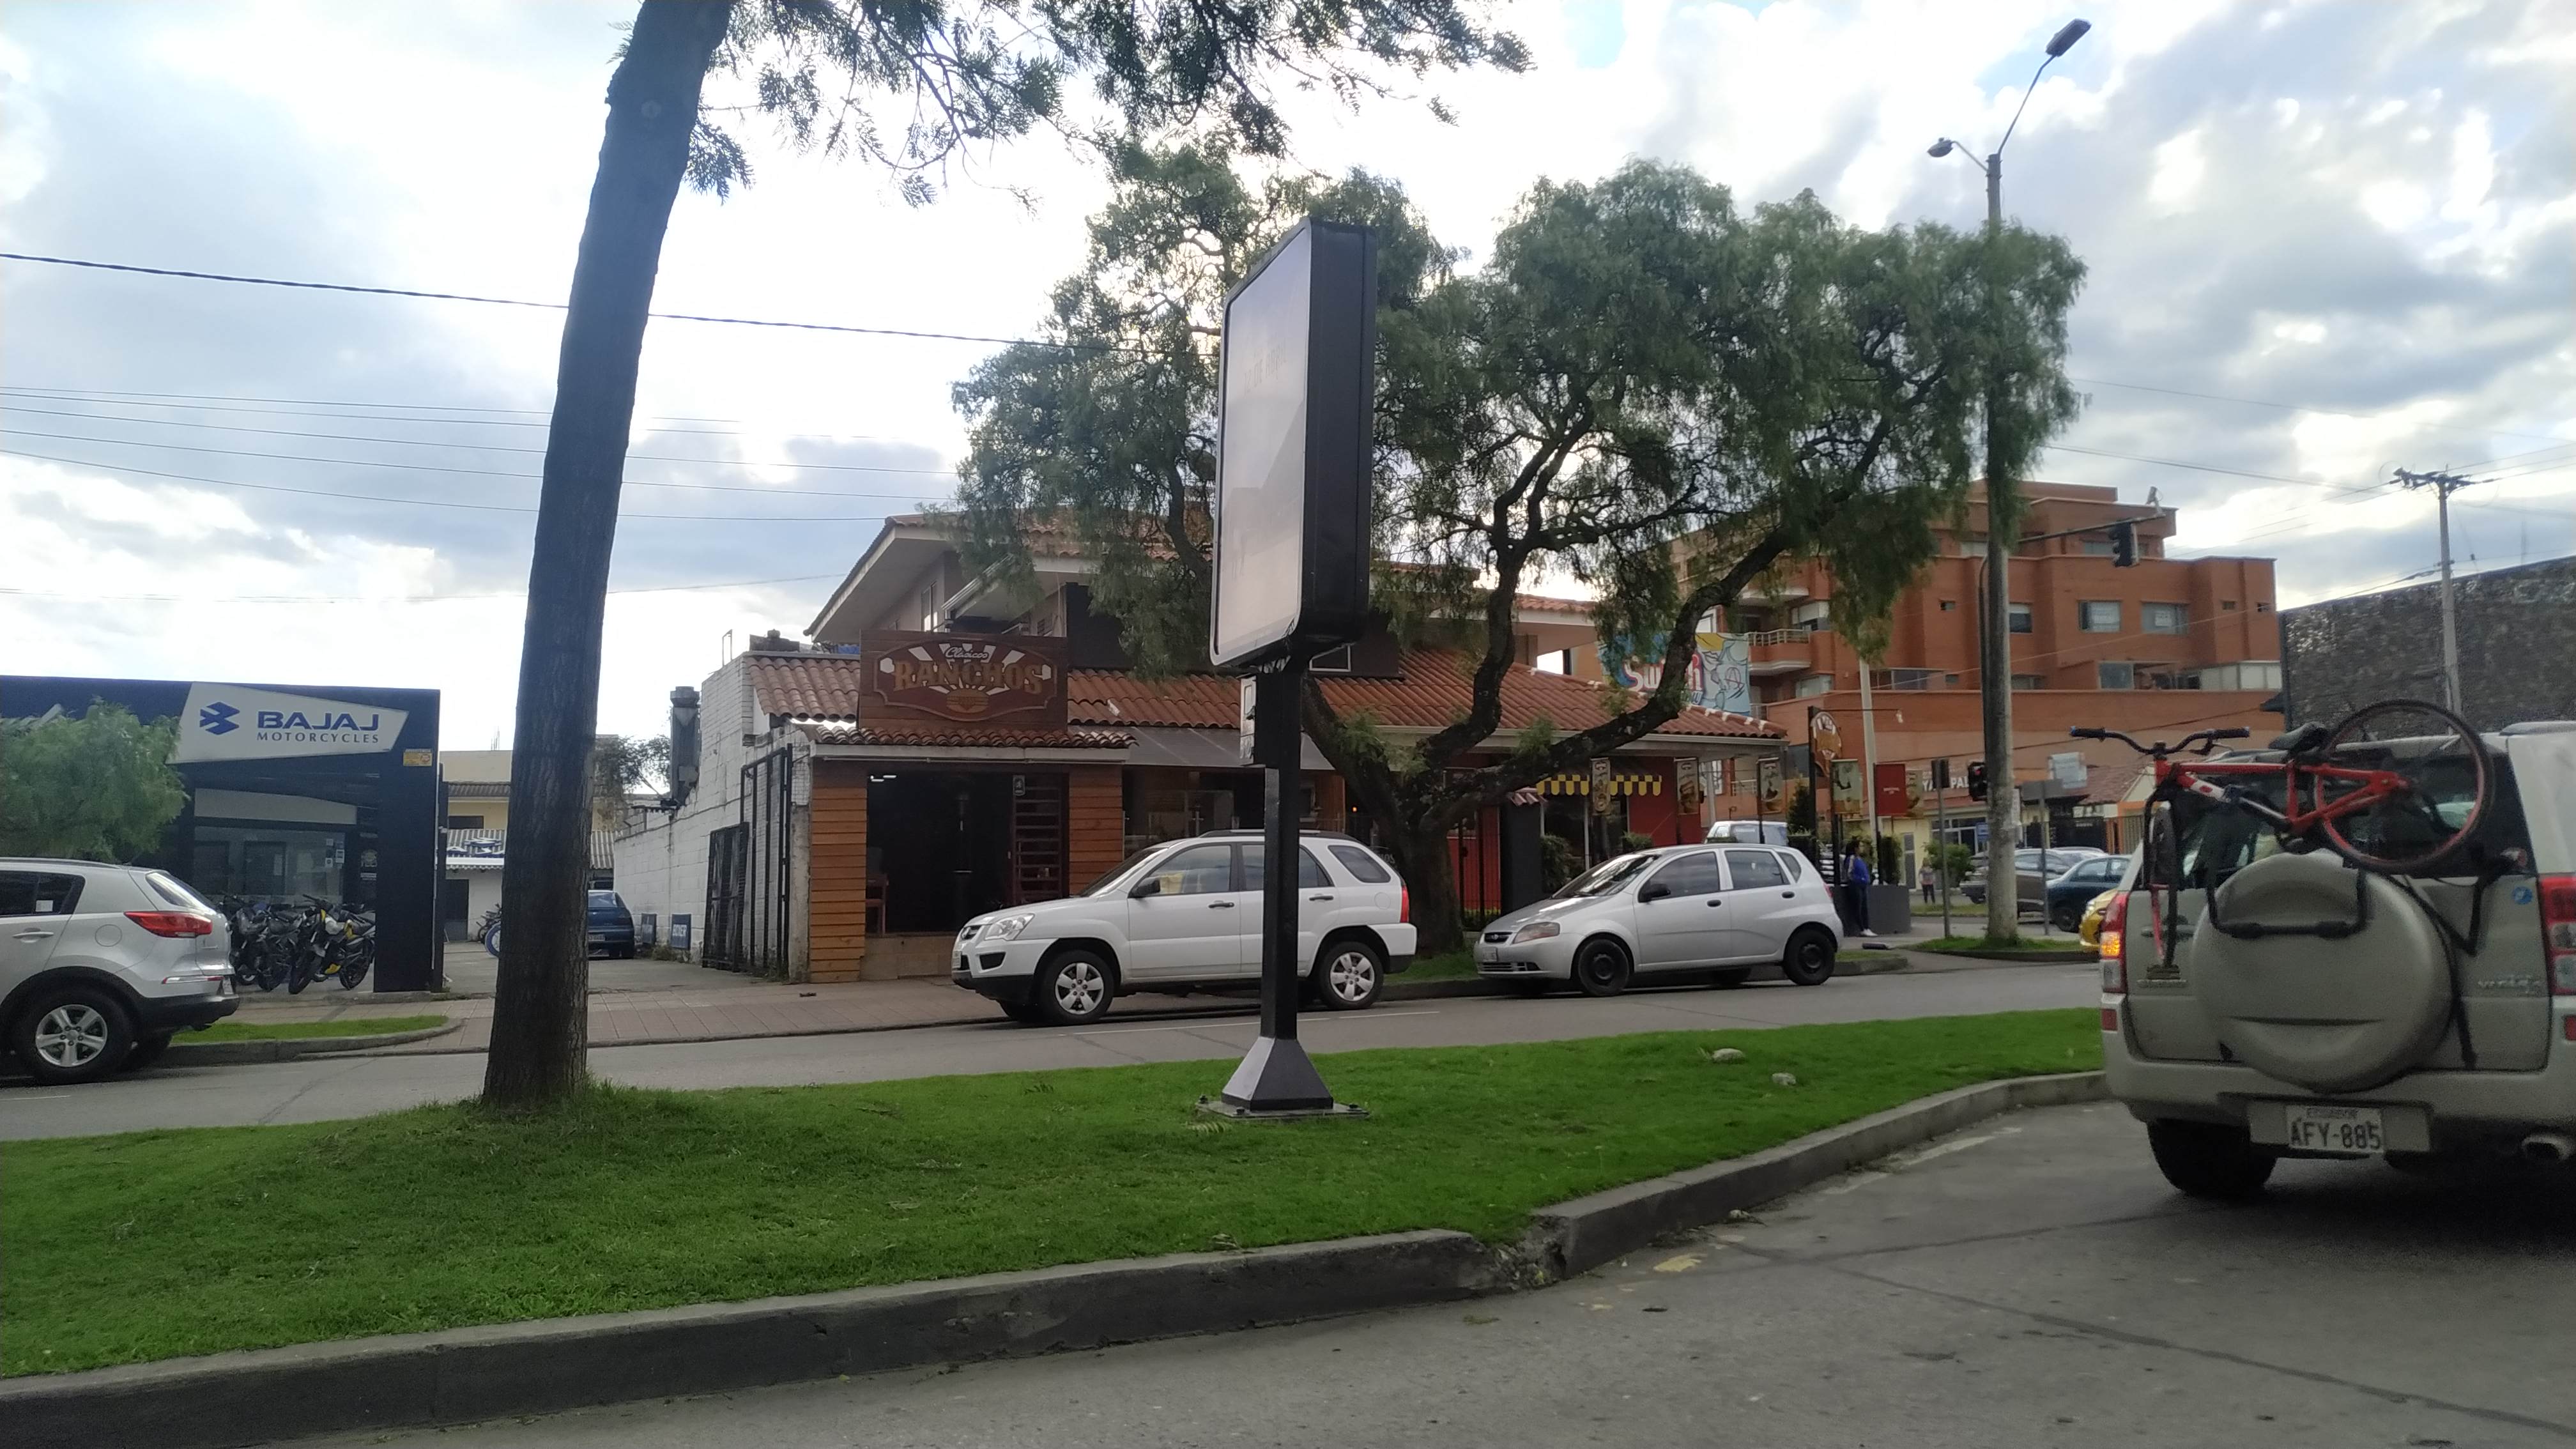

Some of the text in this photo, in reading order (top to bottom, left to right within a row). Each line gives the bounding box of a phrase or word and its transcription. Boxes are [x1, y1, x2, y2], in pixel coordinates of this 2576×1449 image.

[894, 660, 1043, 694] RANCHOS
[257, 711, 379, 731] BAJAJ
[257, 732, 379, 744] MOTORCYCLES
[2290, 1120, 2381, 1149] AFY-885
